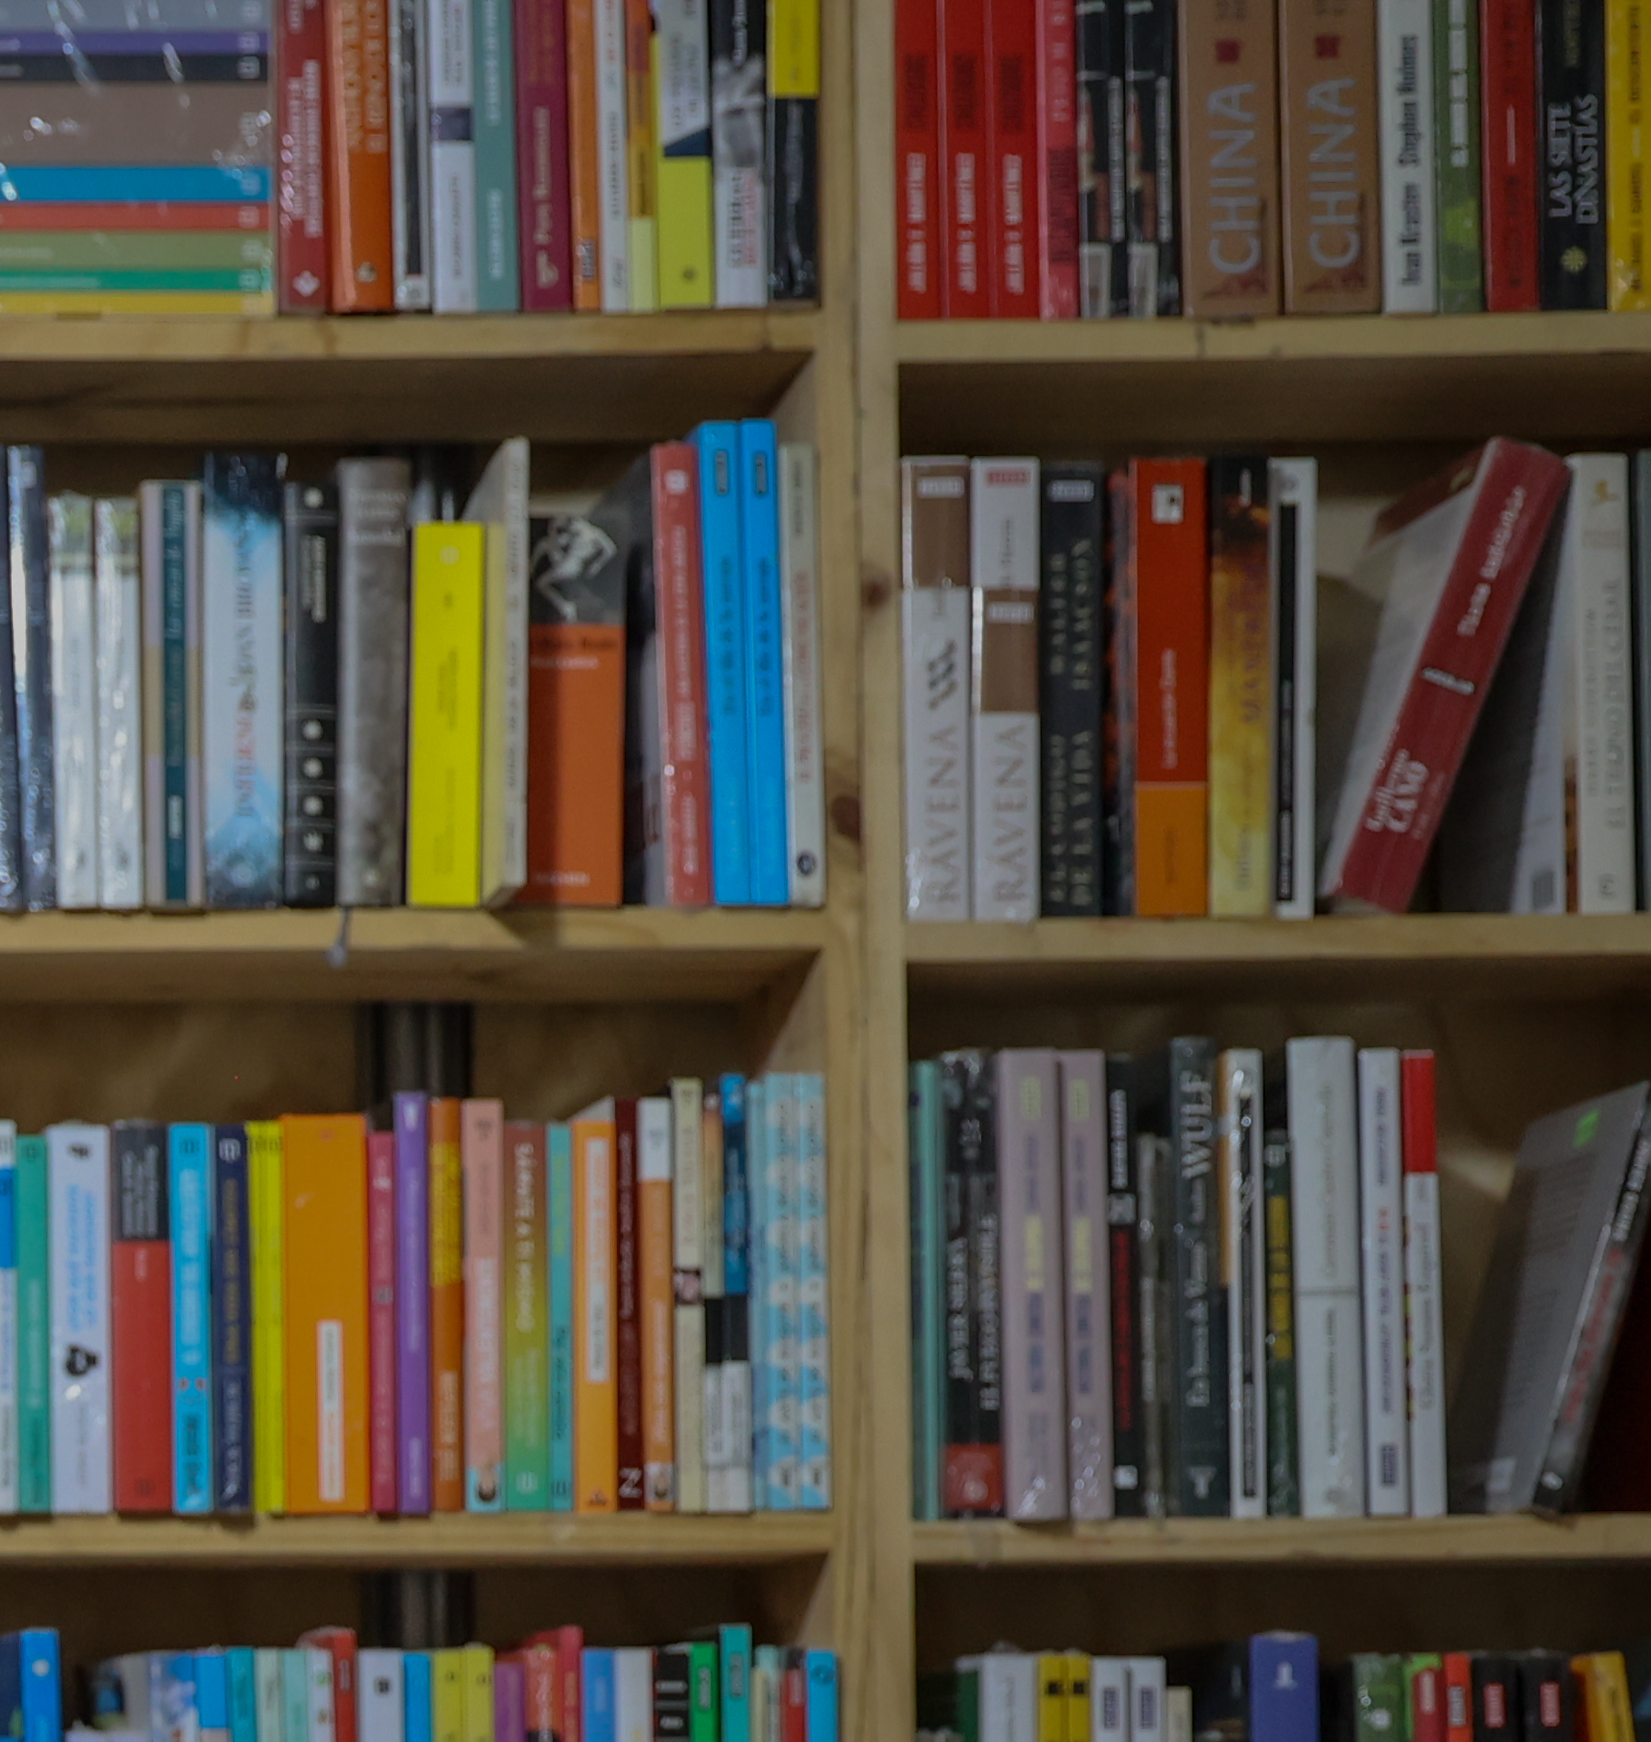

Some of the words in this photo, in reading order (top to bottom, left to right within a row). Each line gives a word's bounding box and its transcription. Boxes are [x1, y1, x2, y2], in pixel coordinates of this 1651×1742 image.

[1208, 82, 1259, 275] CHINA
[1309, 76, 1359, 269] CHINA
[1547, 102, 1571, 167] SIETE
[1547, 171, 1572, 218] LAS
[1570, 94, 1599, 224] DINASTÍAS
[922, 724, 960, 906] RÁVENA
[988, 724, 1029, 904] RÁVENA
[1179, 1068, 1213, 1179] WULF
